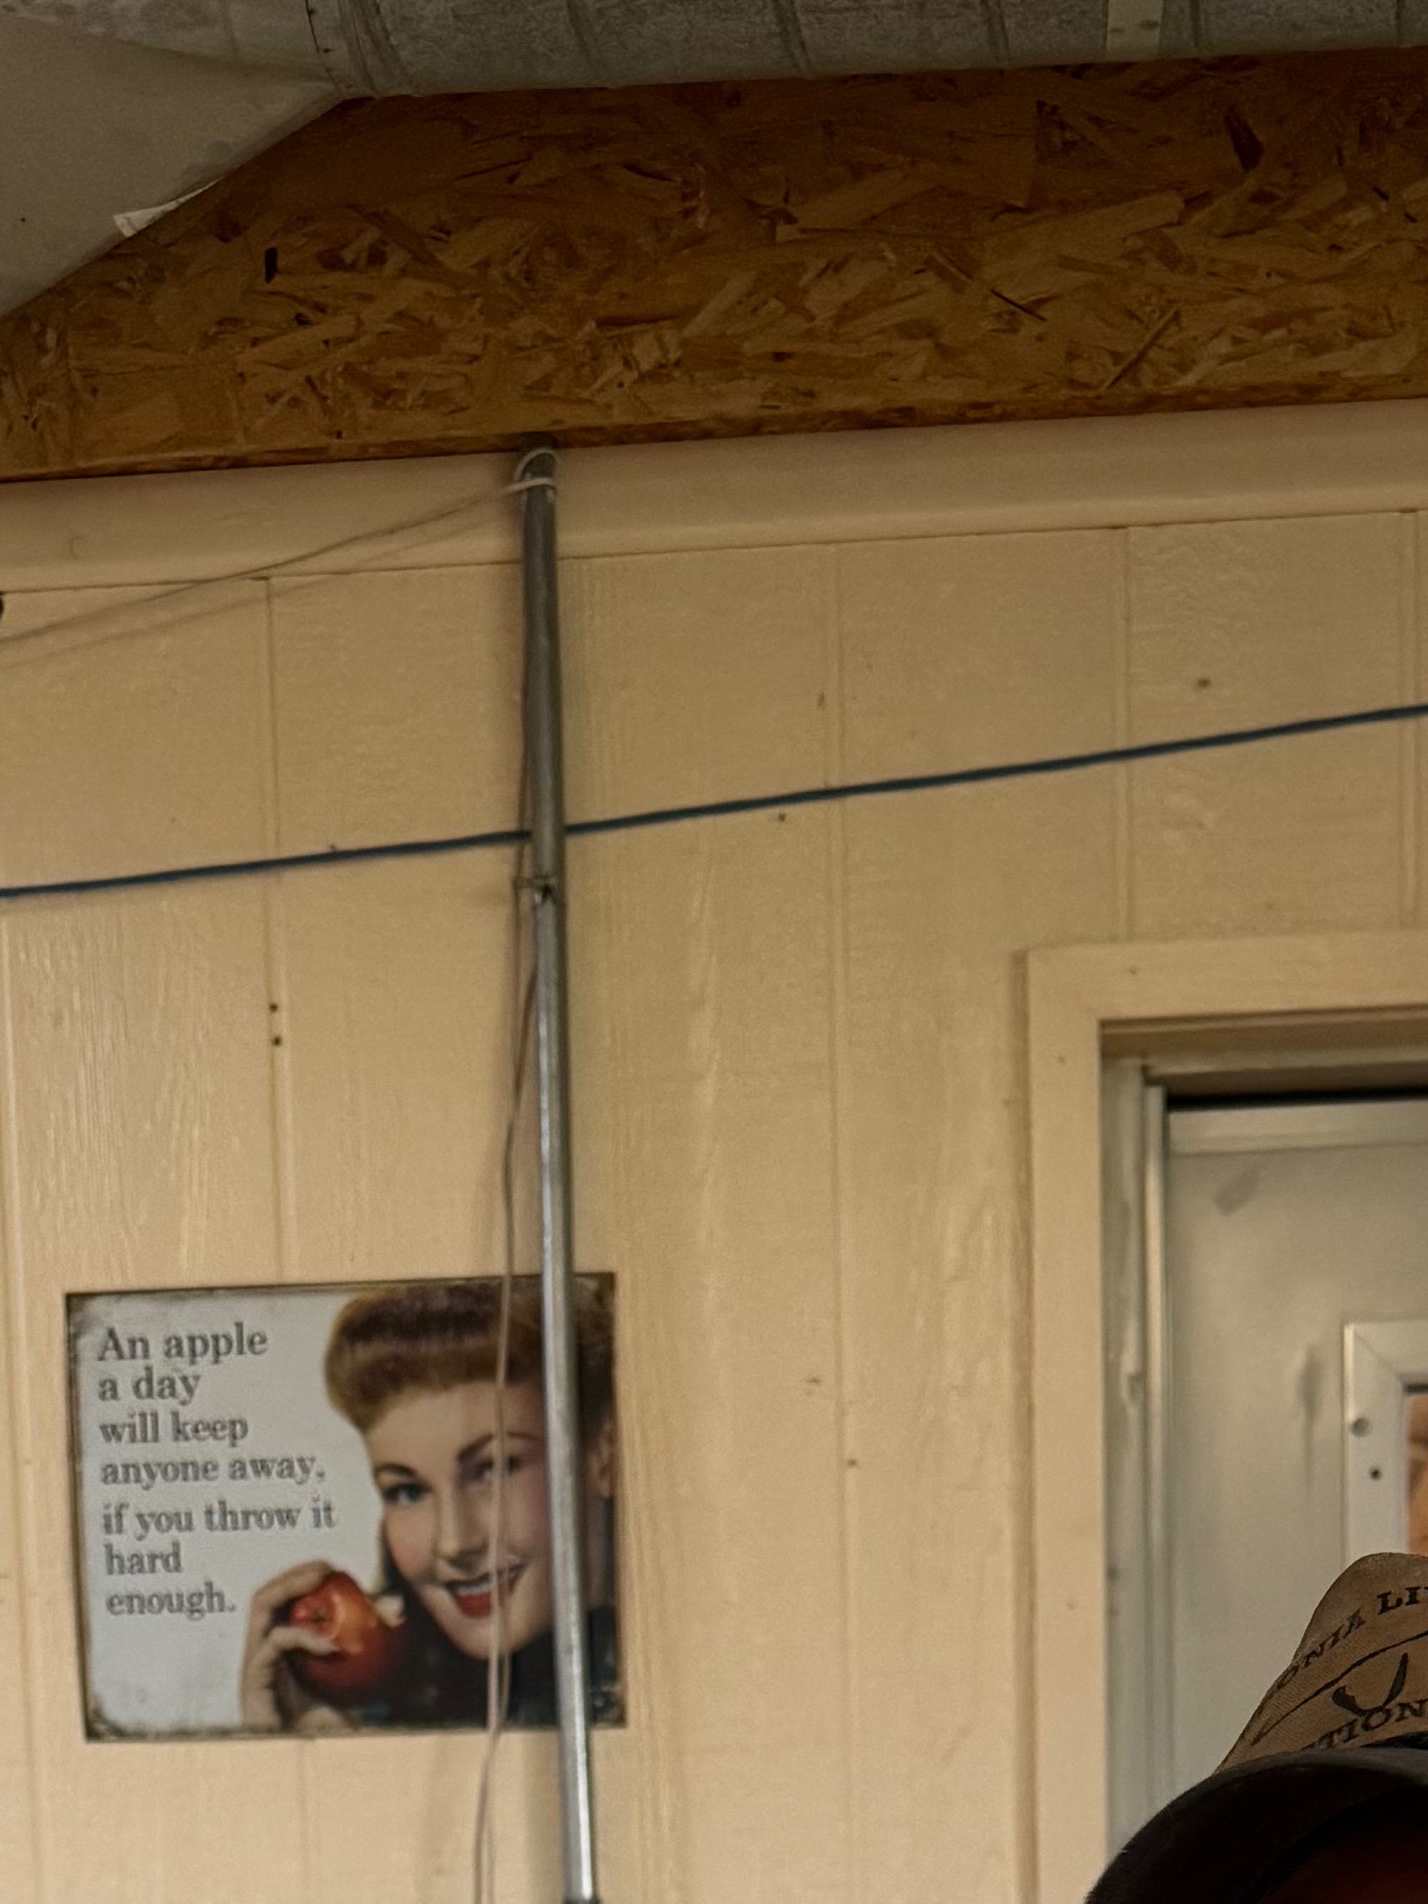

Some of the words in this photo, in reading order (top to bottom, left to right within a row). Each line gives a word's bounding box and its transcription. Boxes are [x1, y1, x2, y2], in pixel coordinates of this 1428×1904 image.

[97, 1327, 150, 1362] An
[163, 1321, 268, 1365] apple
[97, 1377, 121, 1402] a
[131, 1365, 201, 1405] day
[99, 1411, 160, 1444] will
[170, 1410, 248, 1447] keep
[100, 1458, 219, 1490] anyone
[228, 1453, 326, 1486] away,
[102, 1503, 127, 1536] if
[134, 1506, 194, 1541] you
[204, 1500, 300, 1534] throw
[312, 1498, 337, 1530] it
[104, 1542, 182, 1576] hard
[106, 1581, 237, 1621] enough.
